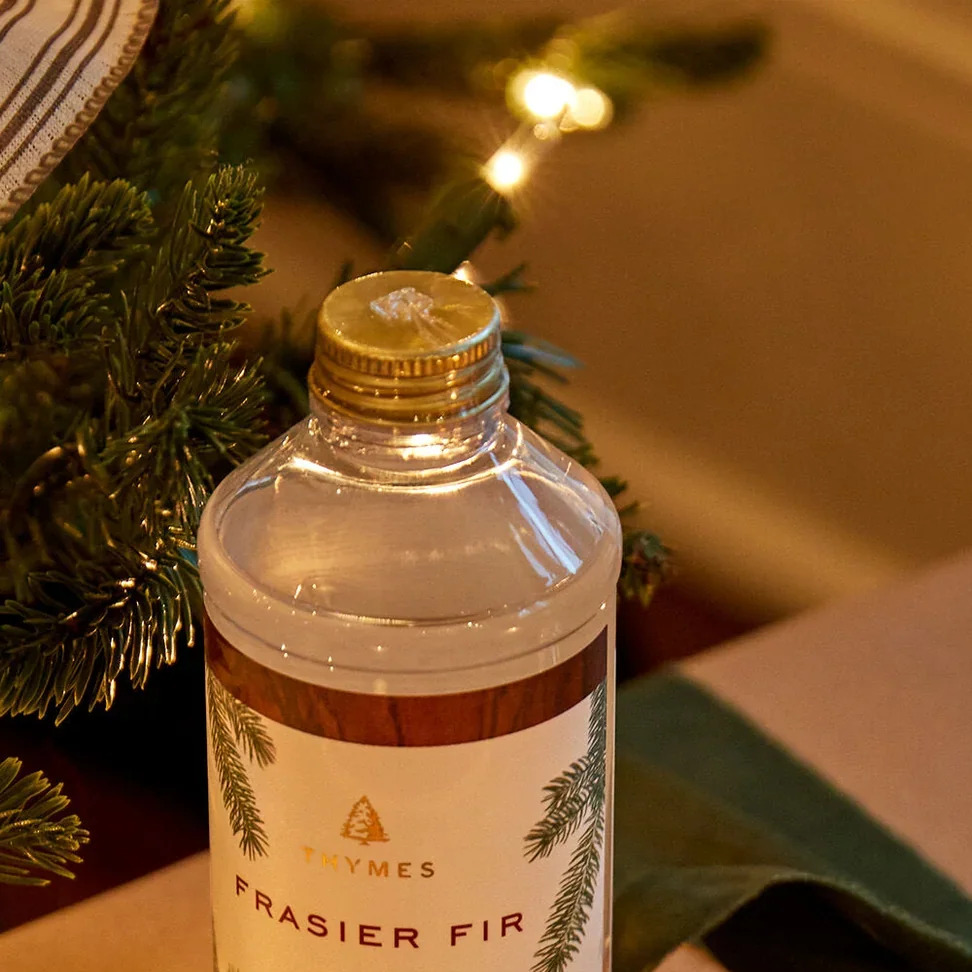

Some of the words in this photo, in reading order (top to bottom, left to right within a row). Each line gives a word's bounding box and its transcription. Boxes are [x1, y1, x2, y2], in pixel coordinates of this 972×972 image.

[301, 845, 435, 878] THYMES
[235, 874, 419, 949] FRASIER
[450, 912, 523, 947] FIR
